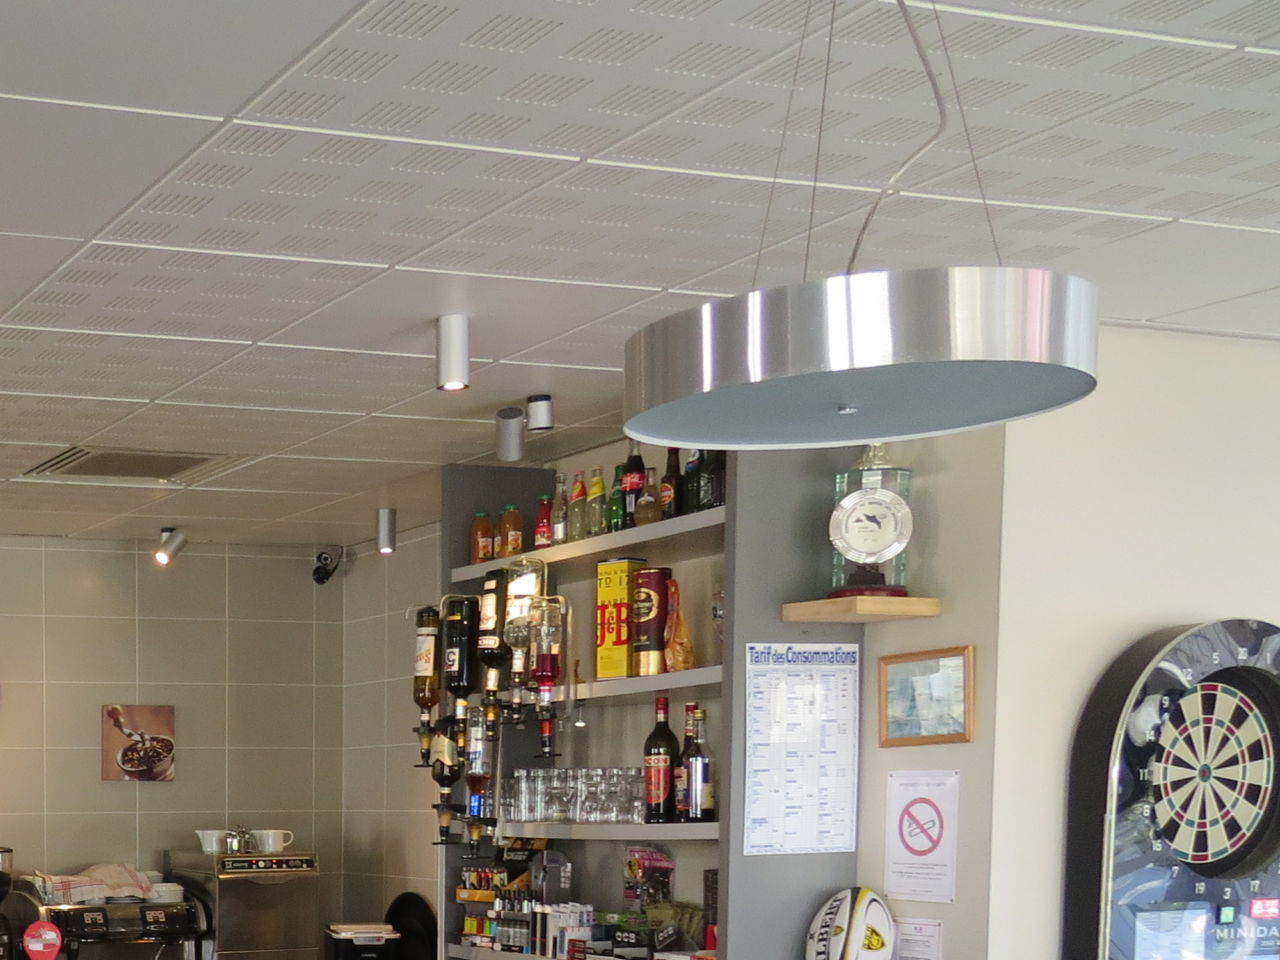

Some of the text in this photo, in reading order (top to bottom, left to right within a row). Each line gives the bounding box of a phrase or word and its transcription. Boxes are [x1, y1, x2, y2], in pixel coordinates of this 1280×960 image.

[748, 646, 857, 664] Tarif des Consommations
[1216, 926, 1280, 940] MINIDA
